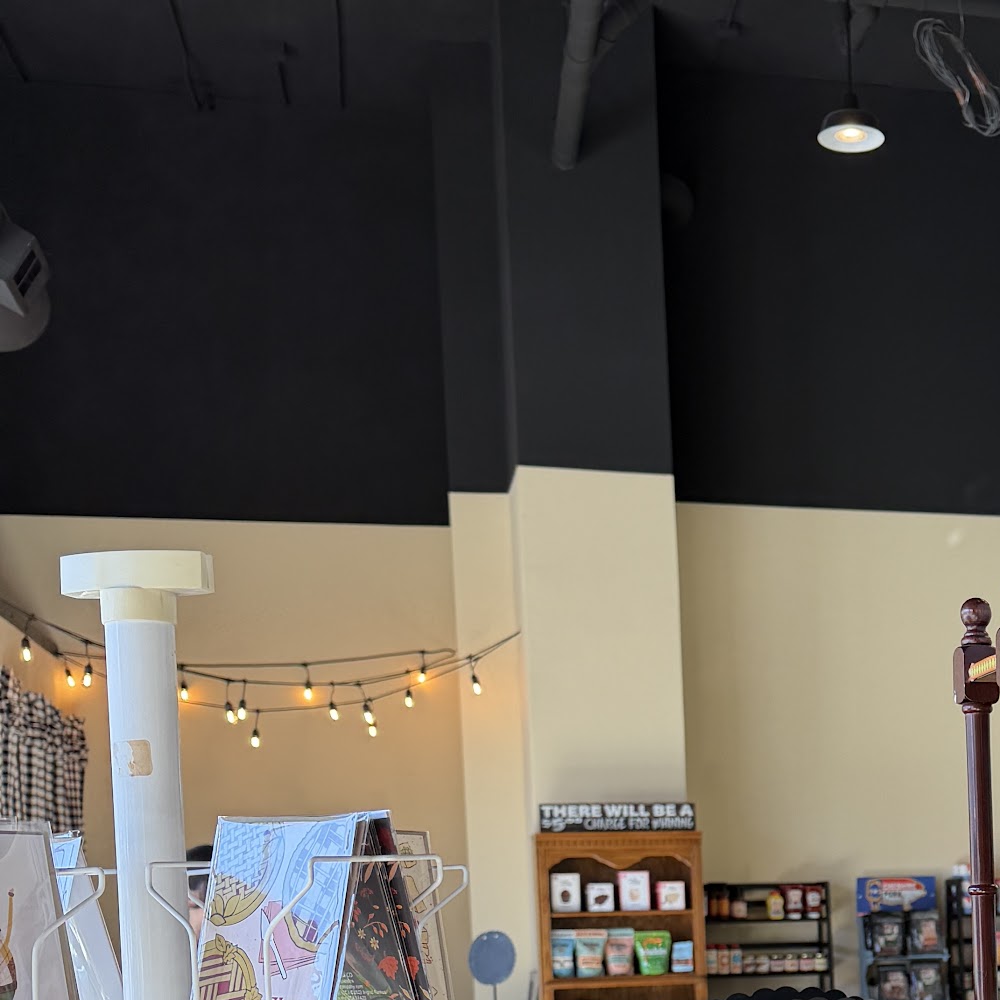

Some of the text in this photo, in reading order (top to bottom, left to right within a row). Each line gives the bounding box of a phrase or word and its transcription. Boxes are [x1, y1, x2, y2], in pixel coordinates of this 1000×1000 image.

[541, 804, 694, 818] THERE WILL BE A
[628, 817, 650, 830] FOR
